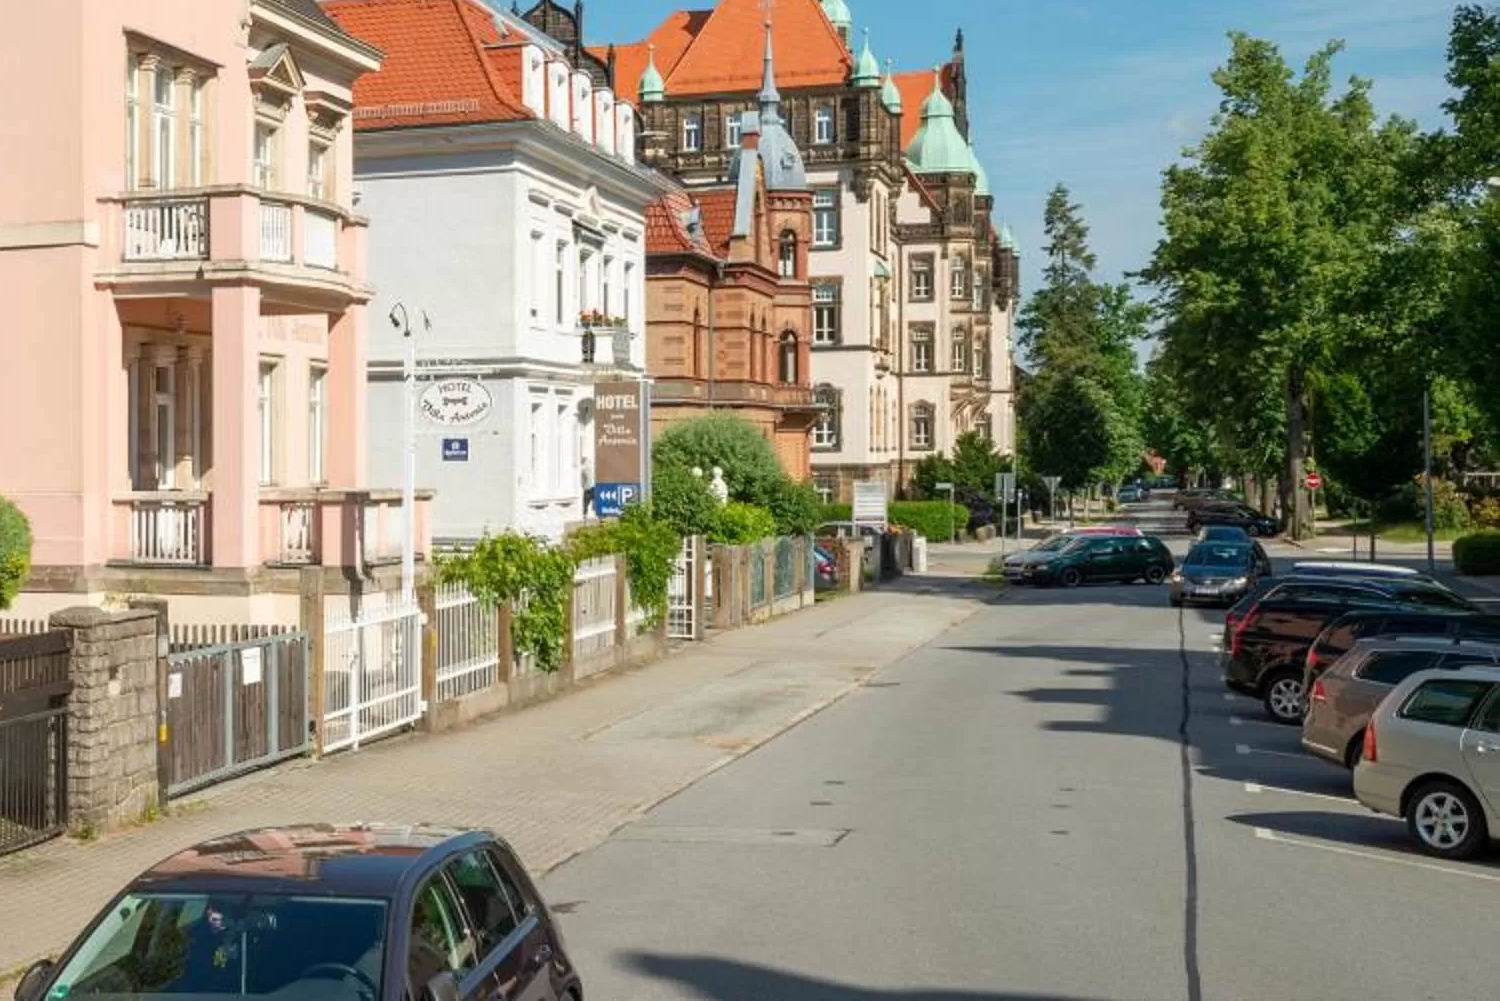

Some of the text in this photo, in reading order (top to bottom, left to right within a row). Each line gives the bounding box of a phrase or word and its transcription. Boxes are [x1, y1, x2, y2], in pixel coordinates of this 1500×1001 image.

[438, 381, 473, 394] HOTEL
[595, 394, 638, 410] HOTEL
[622, 488, 633, 503] P
